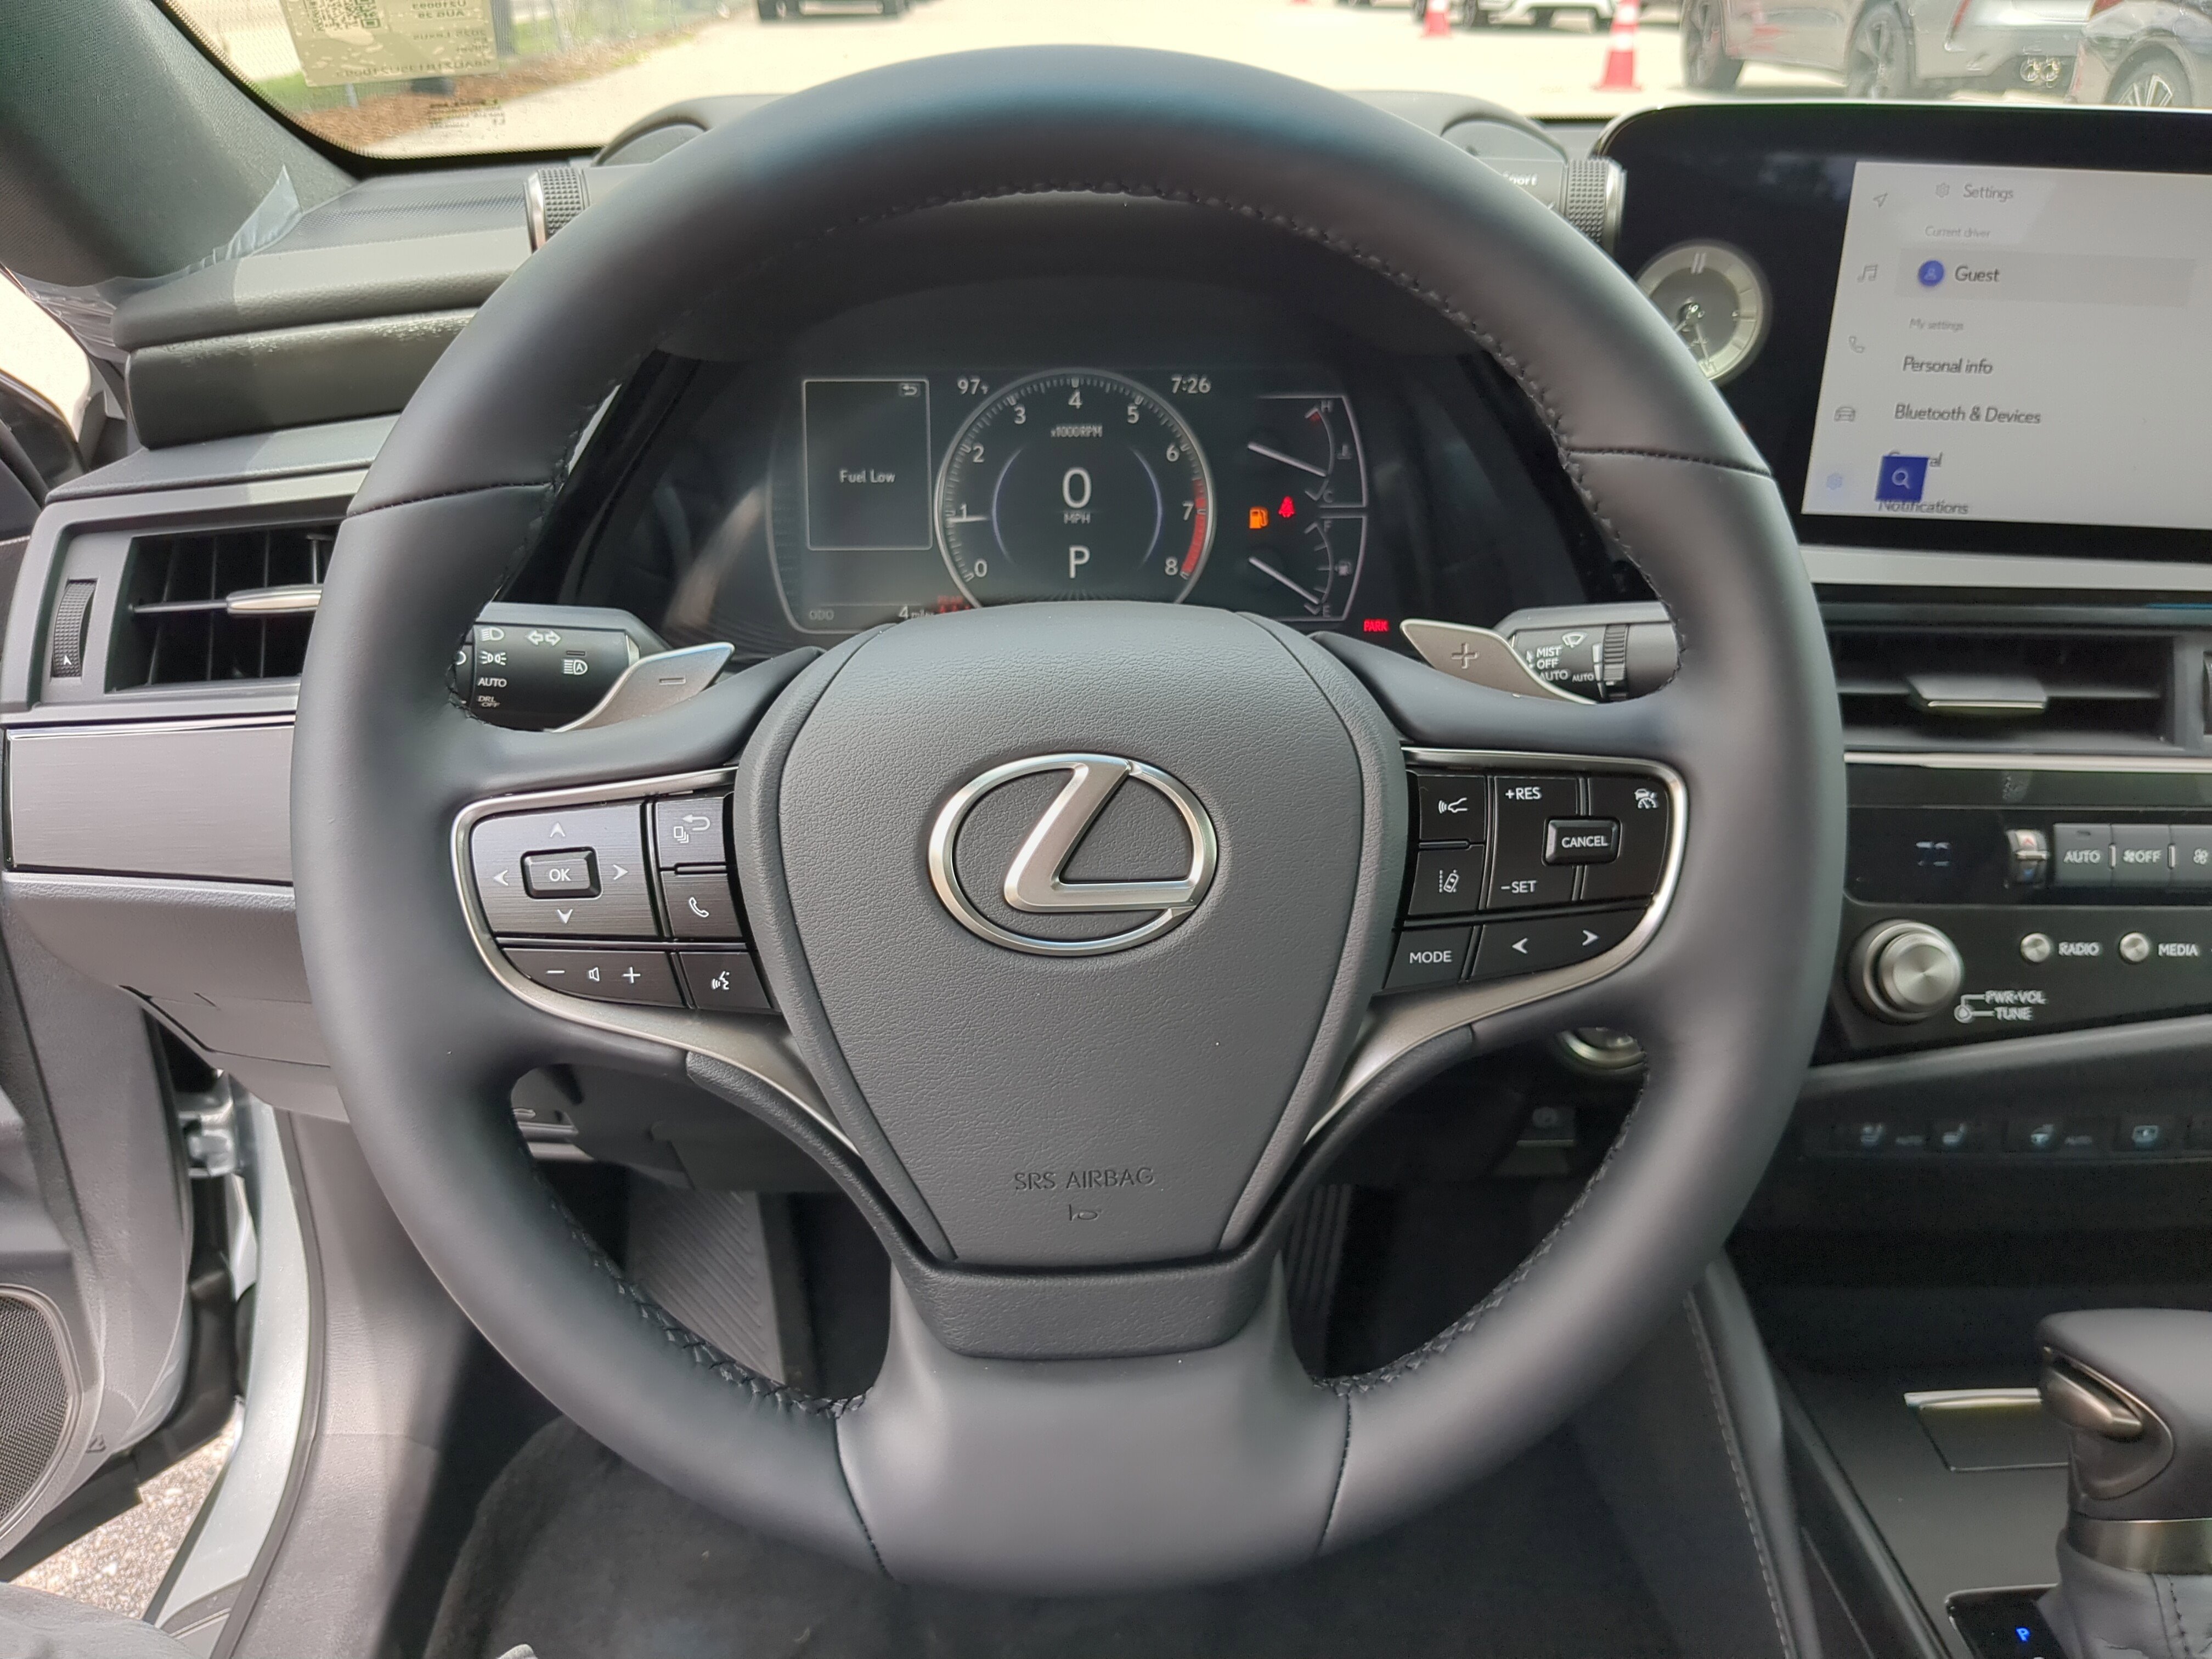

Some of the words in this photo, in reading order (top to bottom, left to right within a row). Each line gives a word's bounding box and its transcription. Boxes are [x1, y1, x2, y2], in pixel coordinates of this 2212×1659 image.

[1962, 184, 2014, 201] Settings
[1925, 225, 1962, 238] Current
[1964, 227, 1991, 239] driver
[1954, 265, 2000, 283] Guest
[1910, 318, 1926, 331] My
[1928, 319, 1964, 332] settings
[1902, 356, 1963, 374] Personal
[1965, 358, 1993, 375] info
[1171, 376, 1211, 394] 7:26
[1068, 391, 1083, 409] 4
[1321, 400, 1333, 413] H
[1014, 405, 1026, 424] 3
[1127, 405, 1139, 424] 5
[1894, 404, 1966, 422] Bluetooth
[1970, 407, 1982, 422] &
[1985, 407, 2041, 425] Devices
[972, 445, 985, 462] 2
[1166, 444, 1180, 462] 6
[839, 469, 866, 483] Fuel
[870, 469, 896, 483] Low
[1062, 467, 1092, 509] 0
[1323, 490, 1334, 503] C
[959, 504, 968, 520] 1
[1182, 502, 1195, 521] 7
[1877, 500, 1970, 515] Notifications
[1063, 512, 1091, 524] MPH
[1323, 520, 1333, 532] F
[974, 558, 988, 577] 0
[1068, 545, 1091, 579] P
[1165, 556, 1178, 575] 8
[809, 609, 834, 621] ODO
[898, 605, 909, 620] 4
[1322, 605, 1331, 618] E
[1363, 618, 1390, 632] PARK
[1536, 645, 1562, 658] MIST
[1536, 657, 1559, 669] OFF
[1538, 669, 1570, 681] AUTO
[1572, 672, 1594, 682] AUTO
[477, 678, 507, 688] AUTO
[478, 695, 495, 703] DRL
[1561, 835, 1608, 849] CANCEL
[2063, 850, 2101, 864] AUTO
[2135, 849, 2163, 864] OFF
[549, 868, 572, 883] OK
[2058, 943, 2100, 956] RADIO
[2158, 943, 2200, 957] MEDIA
[1409, 950, 1453, 964] MODE
[1995, 1007, 2033, 1021] TUNE
[1014, 1171, 1056, 1190] SRS
[1065, 1166, 1155, 1190] AIRBAG
[2016, 1628, 2030, 1642] P
